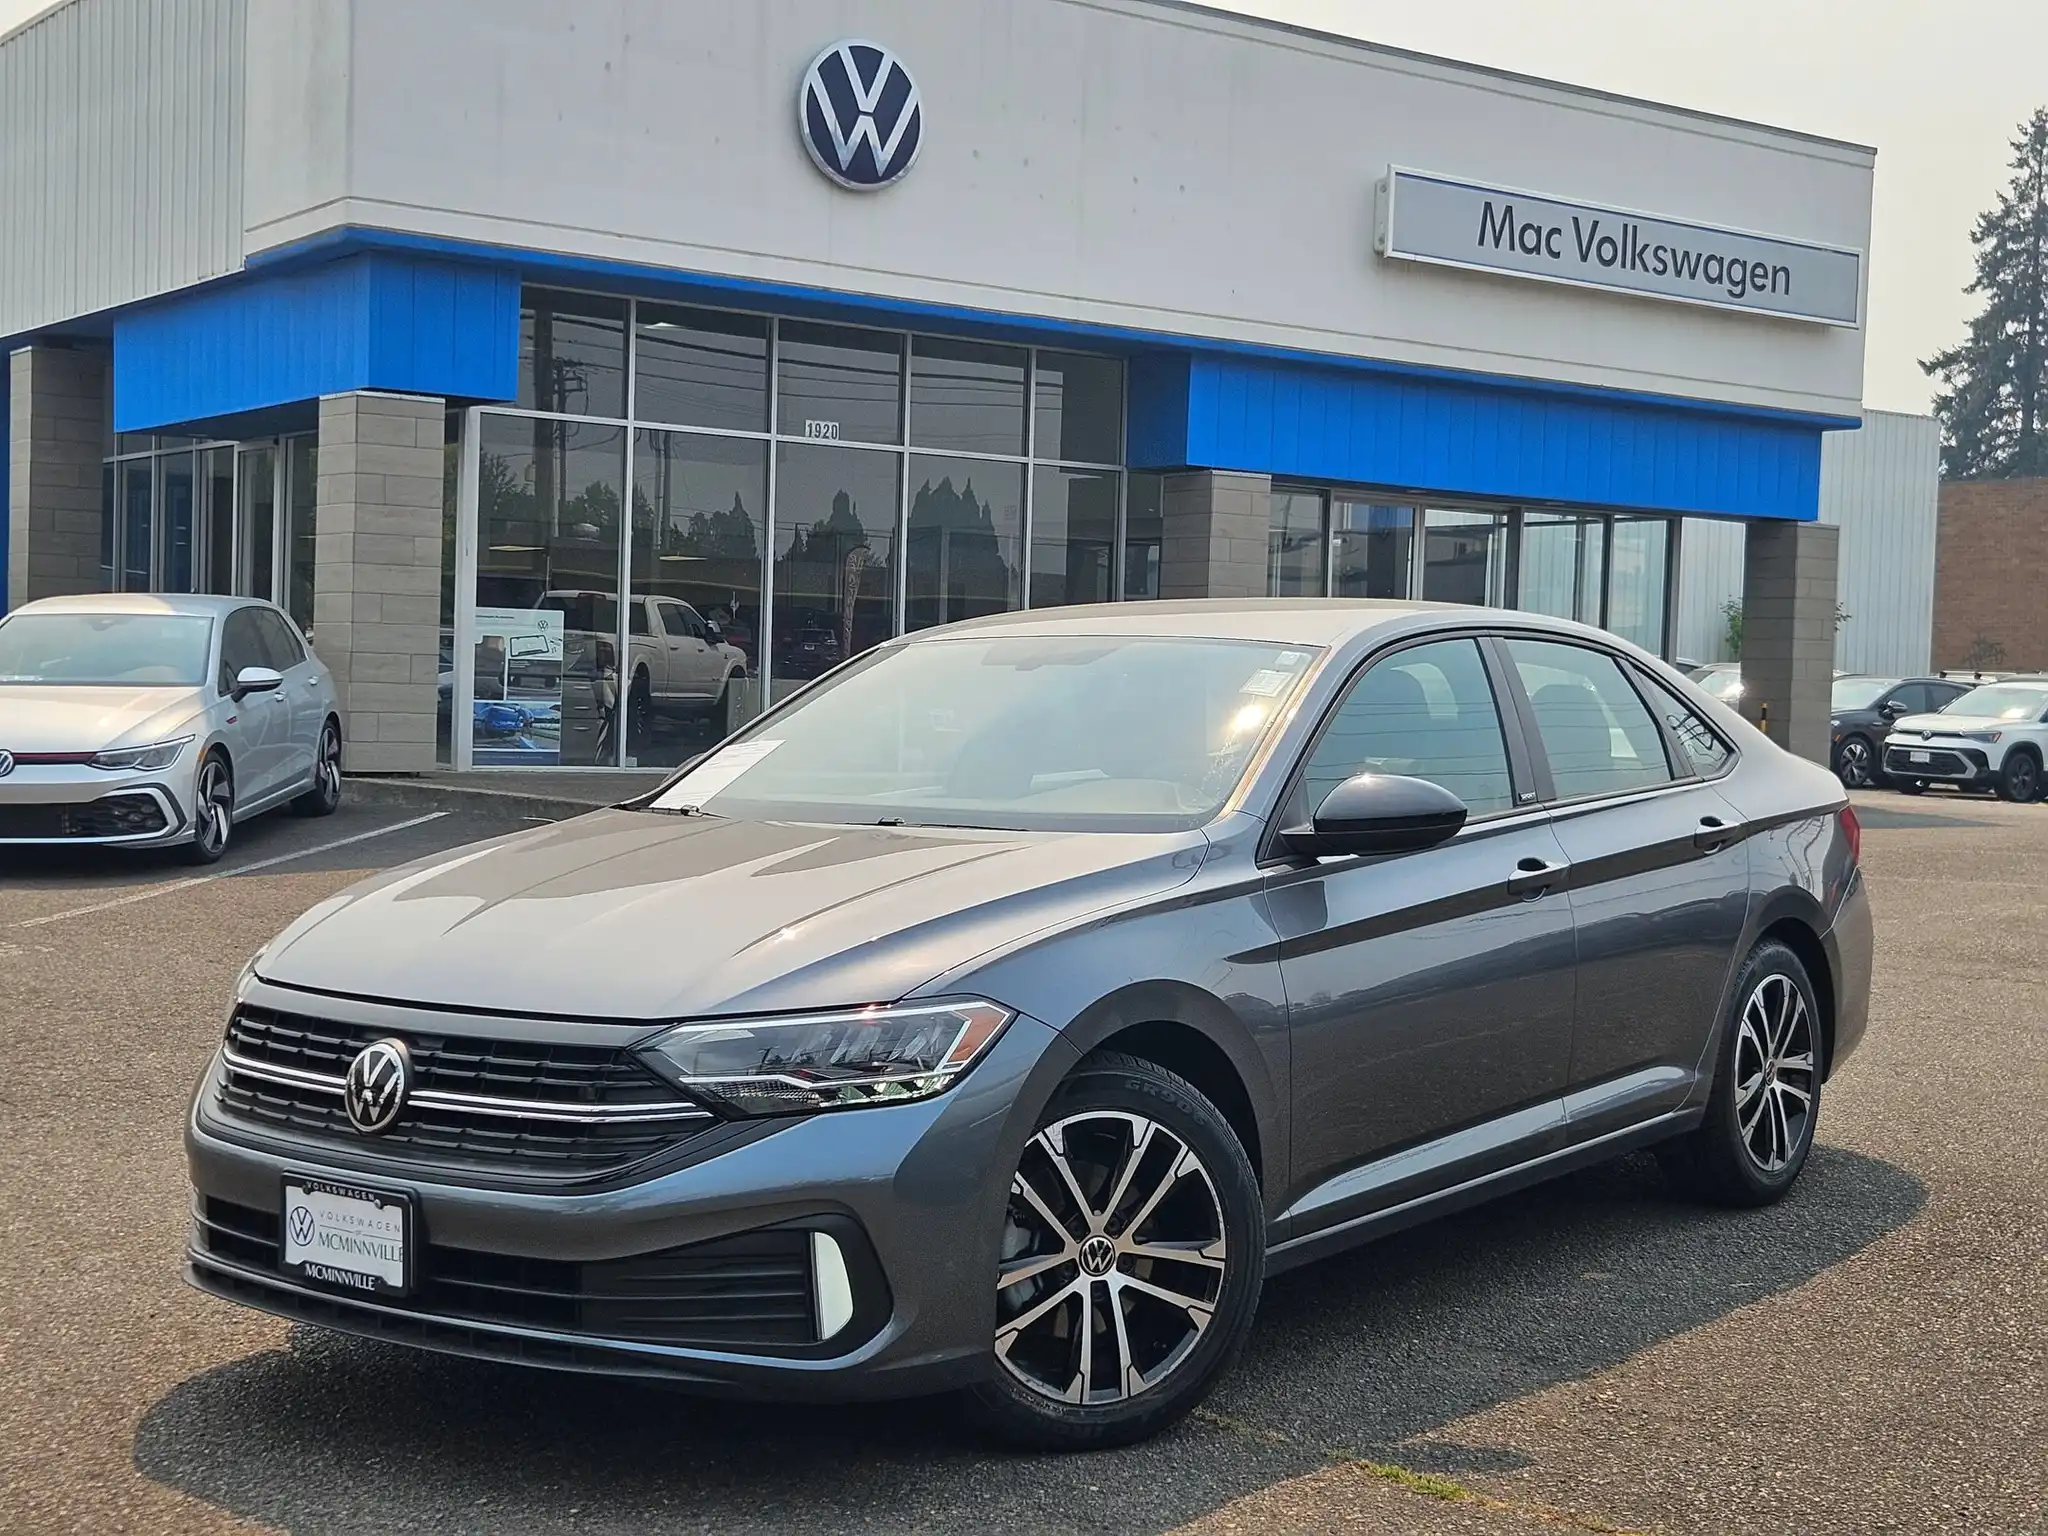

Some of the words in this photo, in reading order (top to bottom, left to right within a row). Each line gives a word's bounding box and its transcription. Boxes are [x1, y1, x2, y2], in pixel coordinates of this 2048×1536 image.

[1477, 201, 1562, 259] Mac
[1572, 217, 1790, 298] Volkswagen
[807, 423, 838, 439] 1920
[306, 1181, 375, 1200] VOLKSWAGEN
[320, 1211, 401, 1233] VOLKSWAGEN
[305, 1263, 375, 1291] MCMINNVILLE
